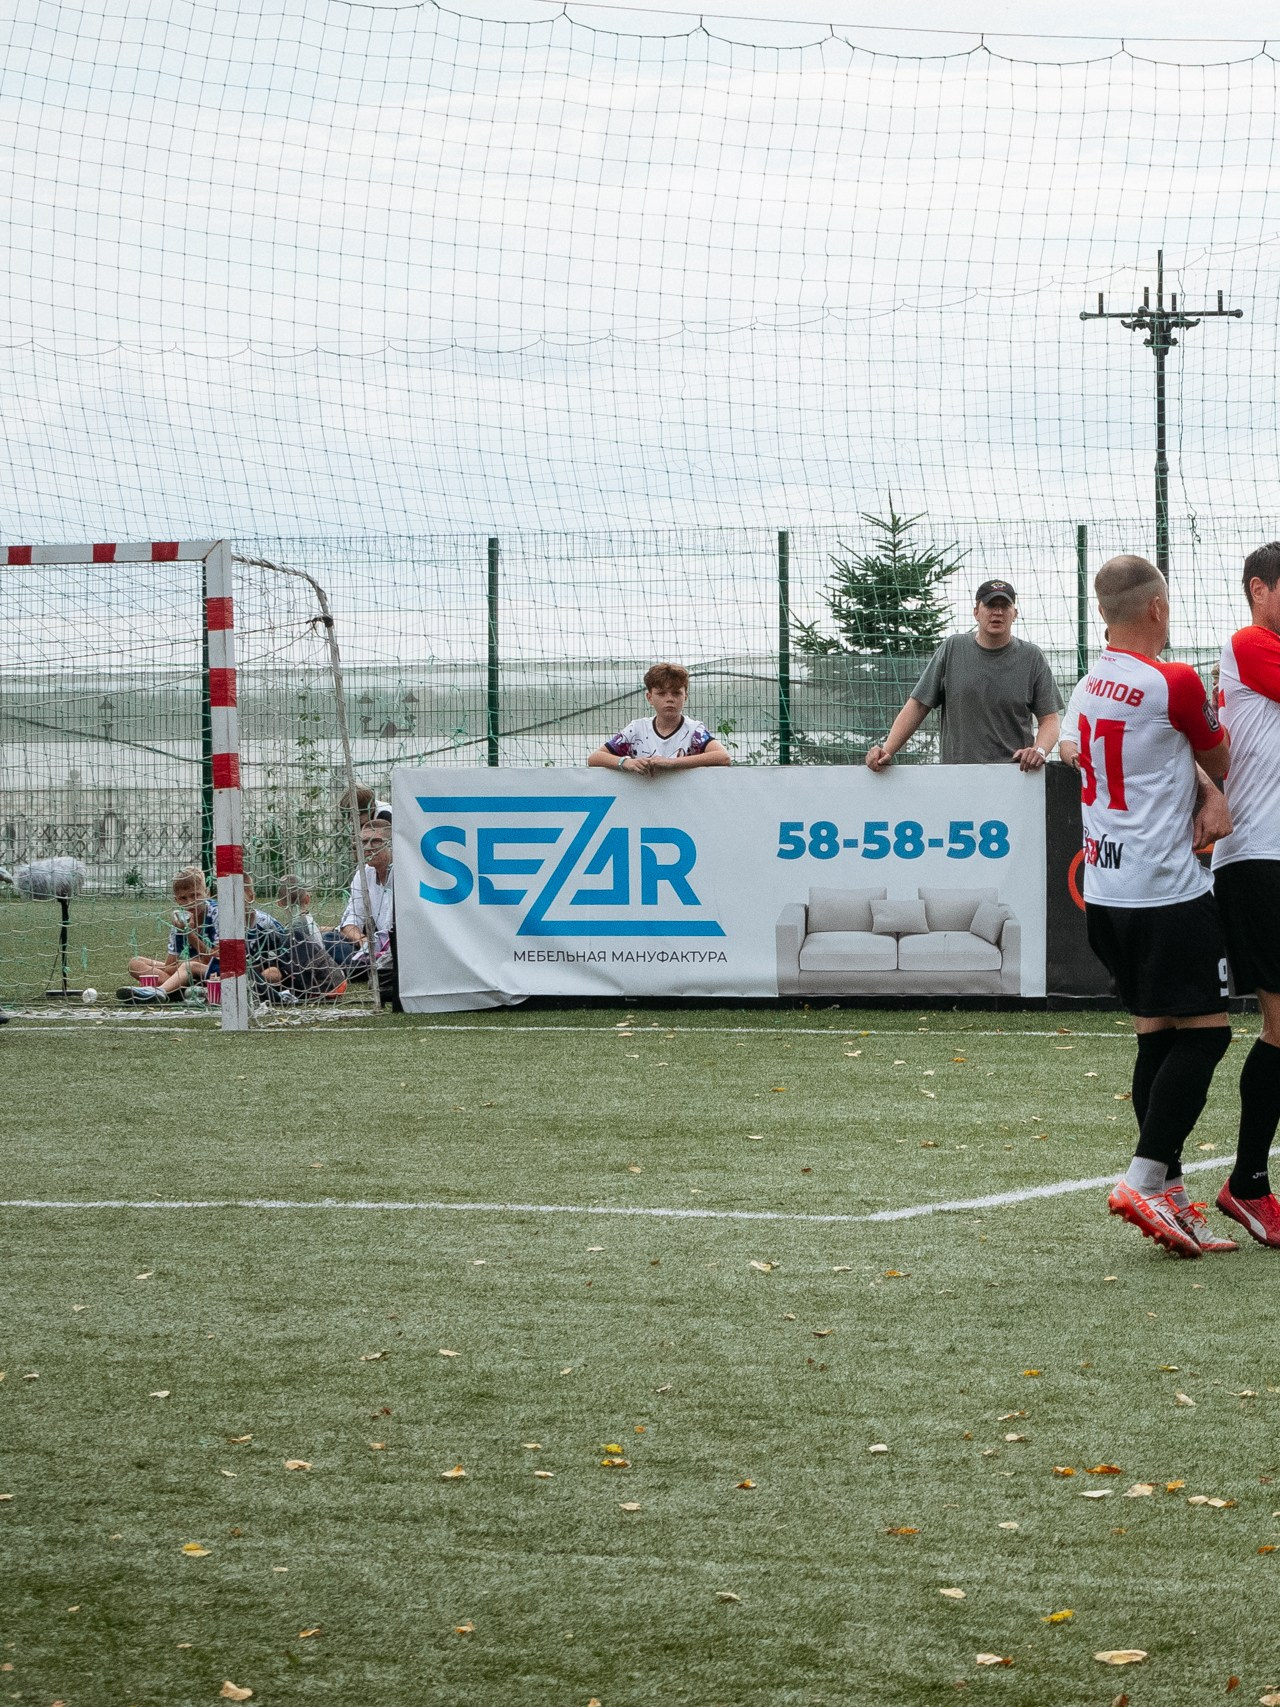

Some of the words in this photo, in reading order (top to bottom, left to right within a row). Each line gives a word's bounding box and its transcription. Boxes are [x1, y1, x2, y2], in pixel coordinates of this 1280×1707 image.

[776, 820, 1011, 860] 58-58-58
[414, 796, 727, 937] SEZAR
[513, 950, 607, 962] МЕБЕЛЬНАЯ
[611, 950, 728, 963] МАНУФАКТУРА
